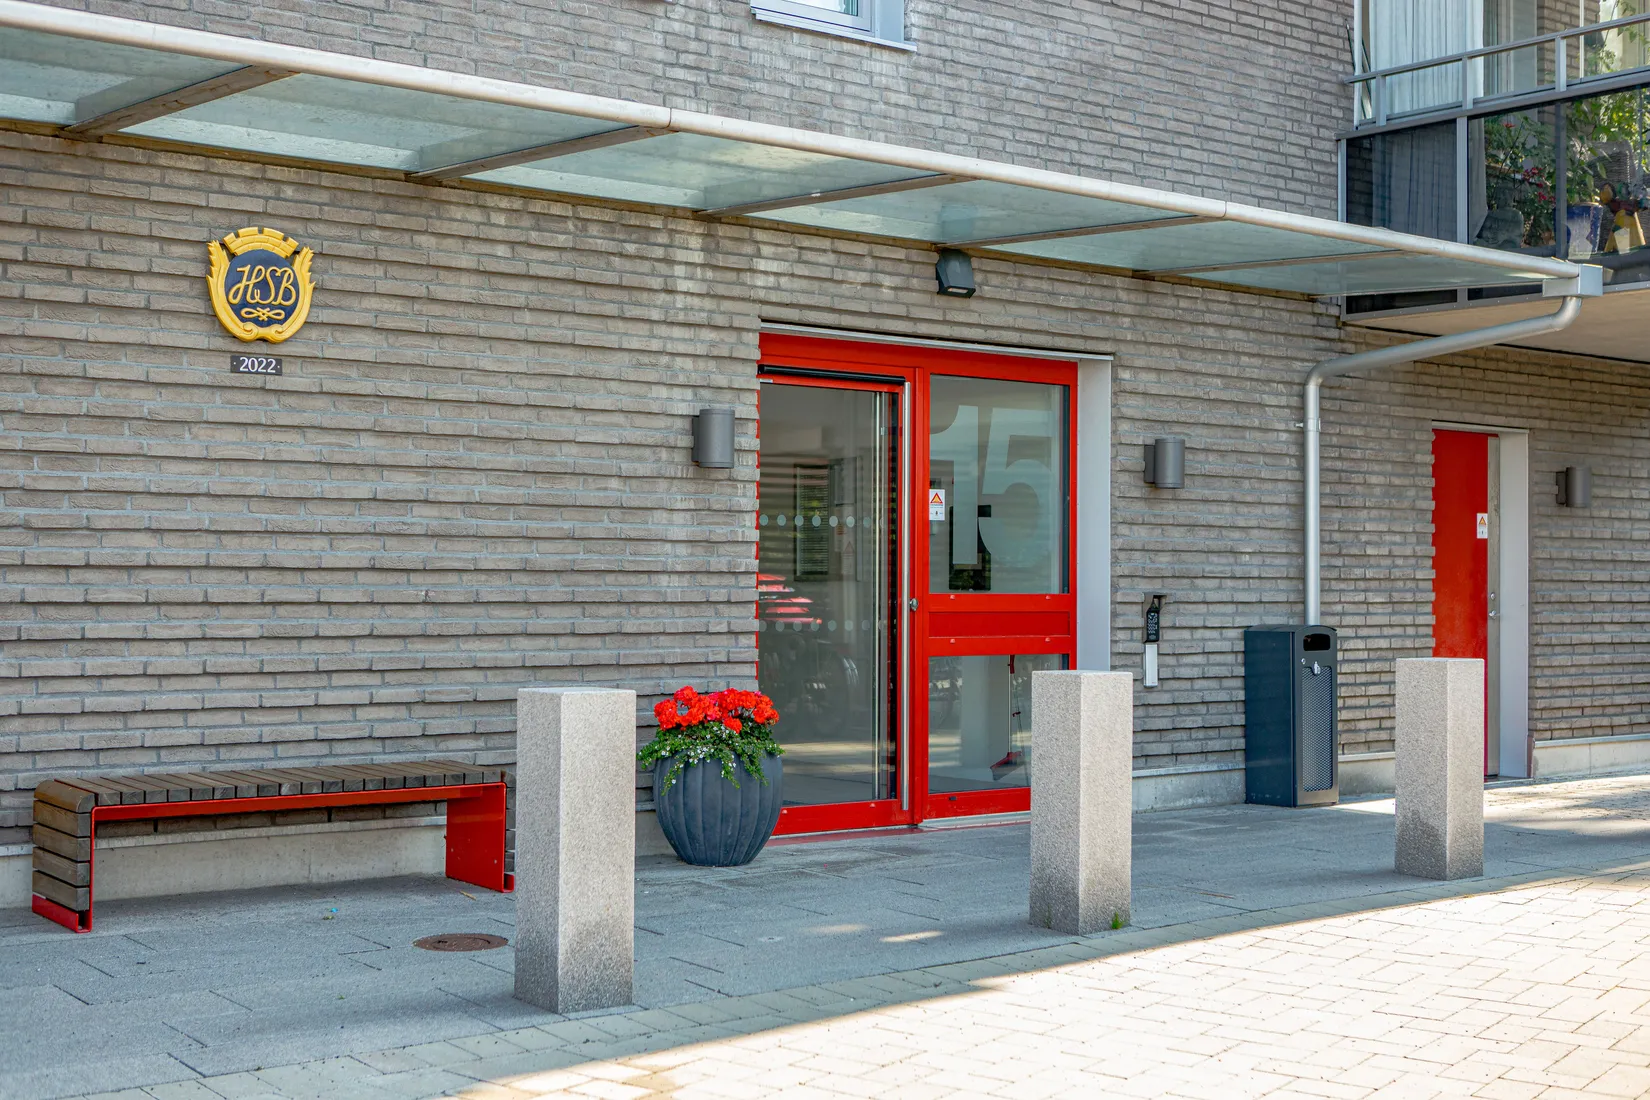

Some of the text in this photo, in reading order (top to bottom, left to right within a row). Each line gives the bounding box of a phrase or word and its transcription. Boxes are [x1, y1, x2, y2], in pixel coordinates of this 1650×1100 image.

[228, 264, 297, 307] HSB
[239, 356, 276, 373] 2022
[930, 405, 1060, 568] 15
